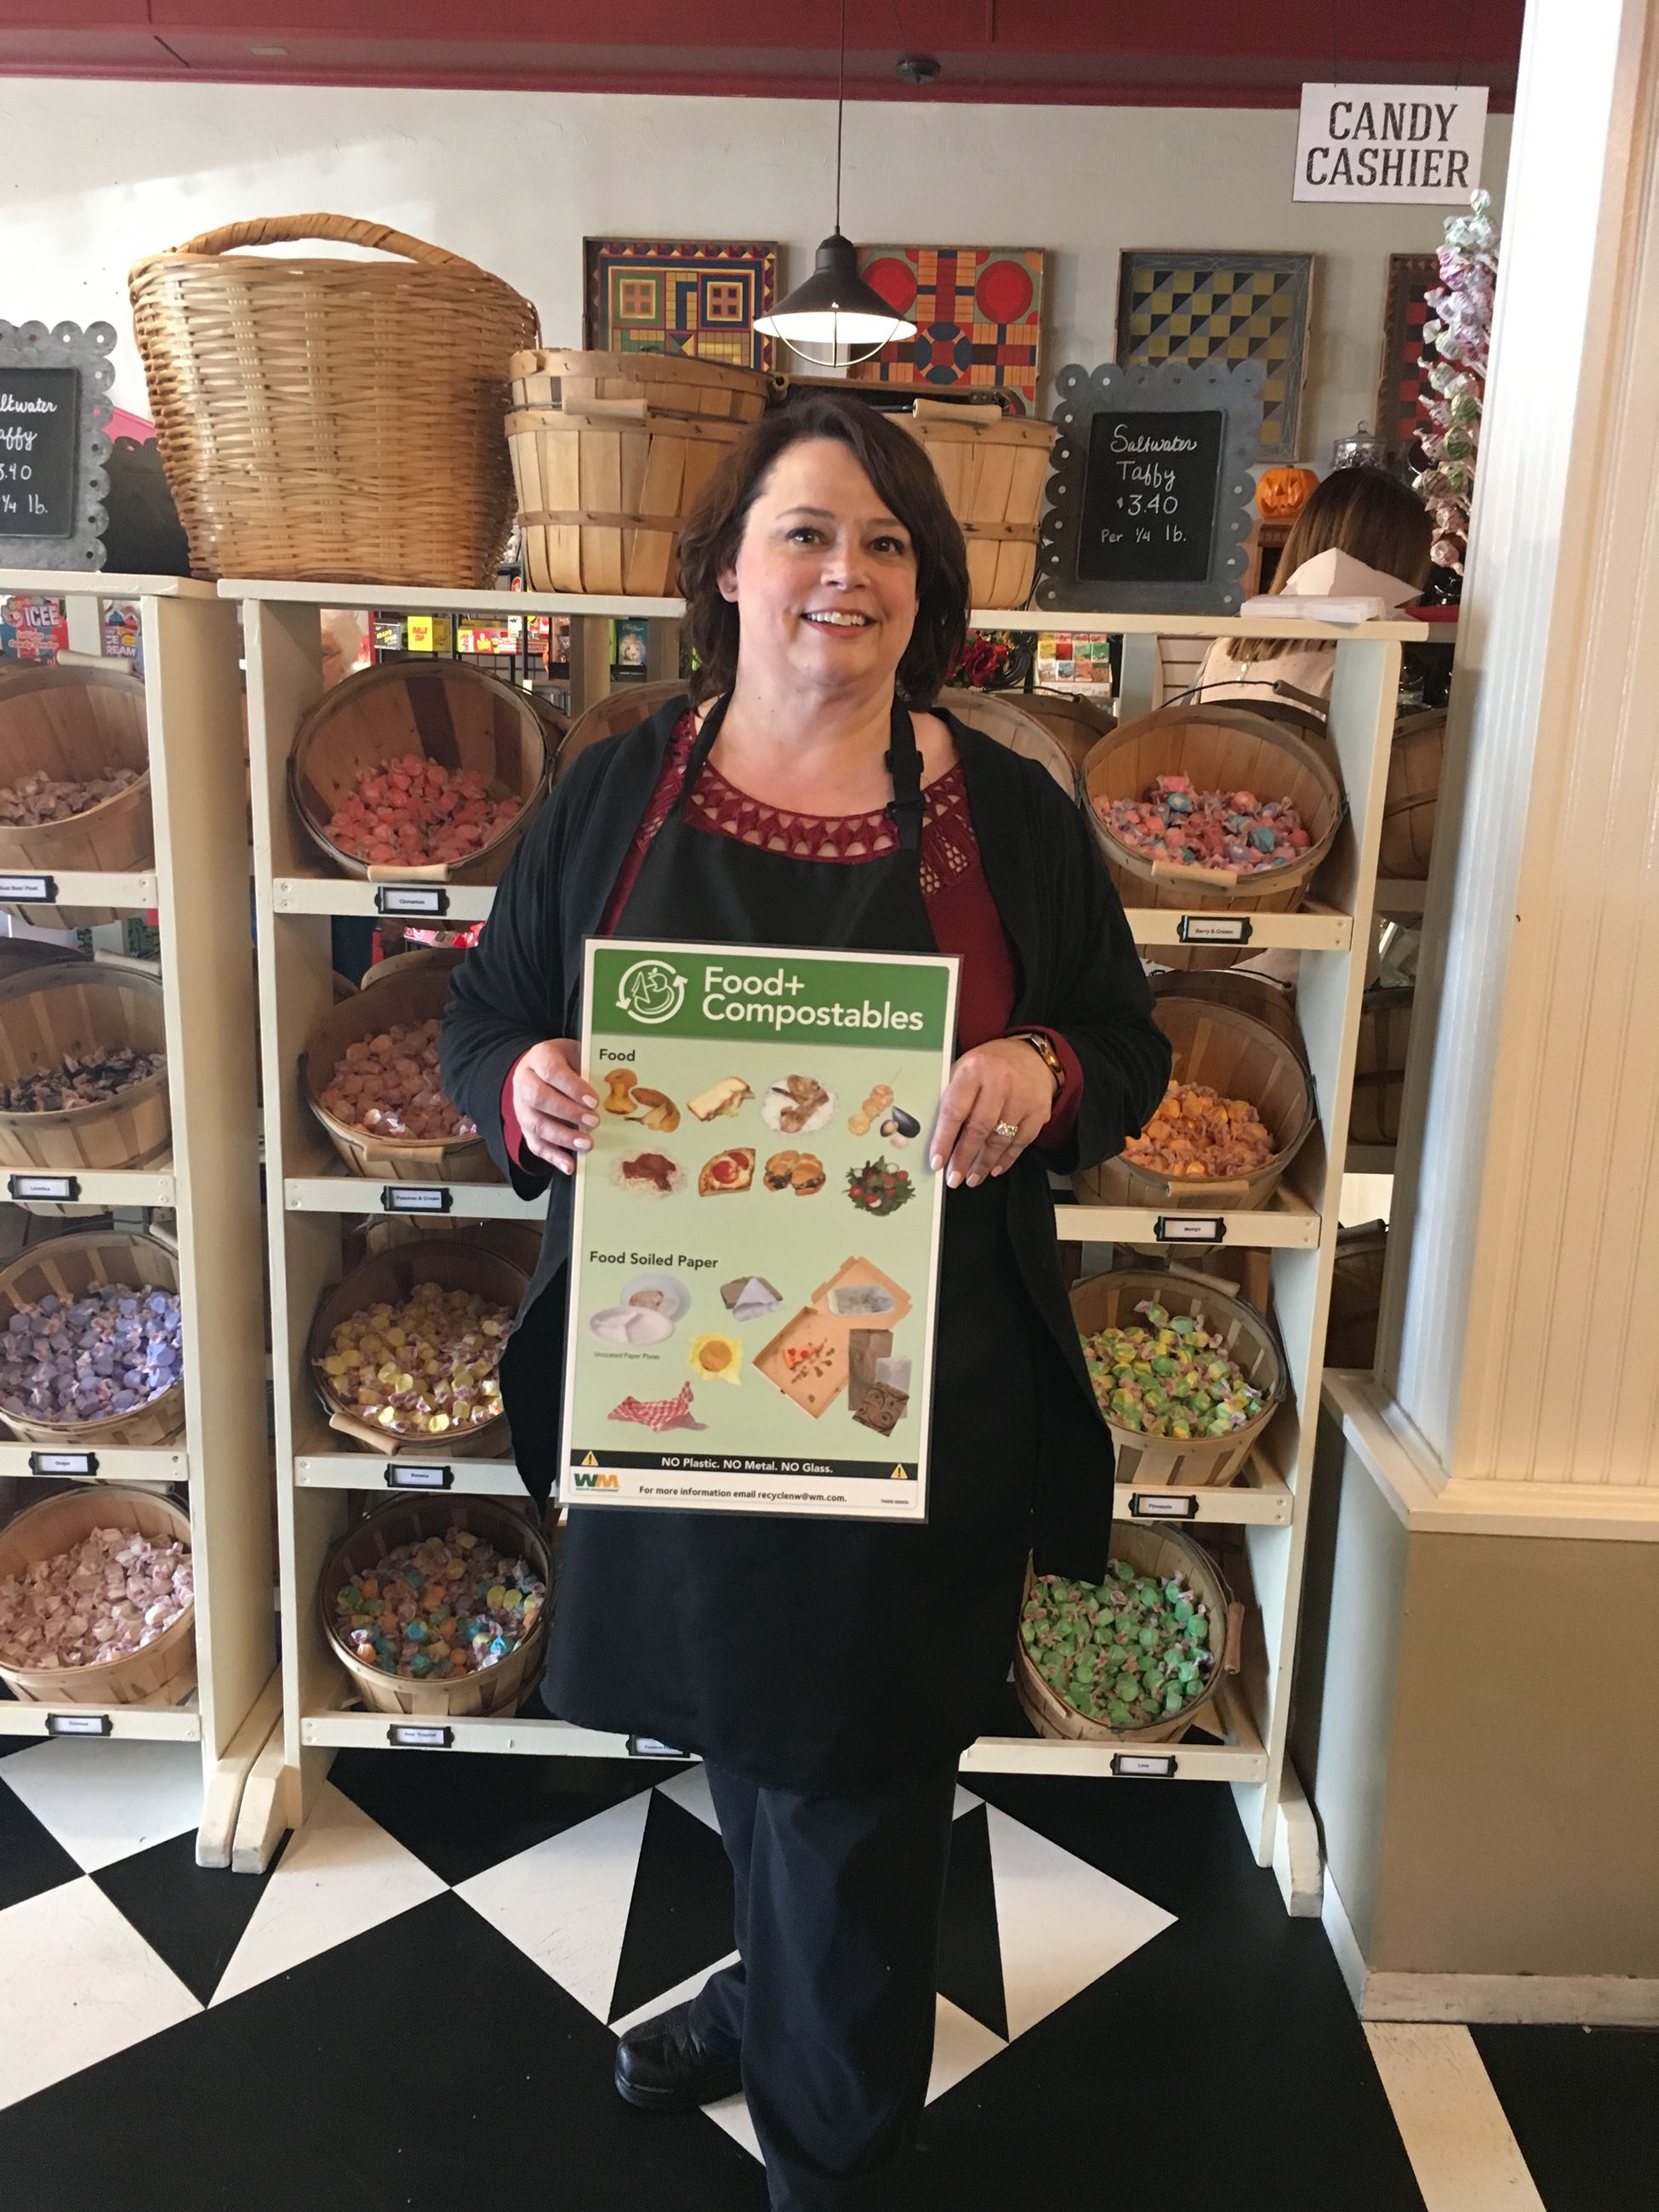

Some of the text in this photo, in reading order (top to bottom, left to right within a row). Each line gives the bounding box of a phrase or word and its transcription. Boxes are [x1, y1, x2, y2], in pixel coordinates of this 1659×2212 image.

[1329, 101, 1458, 142] CANDY
[1306, 146, 1469, 188] CASHIER
[0, 393, 58, 413] ltwater
[0, 426, 38, 451] affy
[1110, 424, 1198, 453] Saltwater
[0, 463, 32, 481] .40
[1116, 460, 1176, 492] Taffy
[1101, 528, 1123, 543] Per
[1166, 524, 1188, 543] lb.
[24, 605, 60, 627] ICEE
[106, 645, 136, 657] REAM
[704, 966, 805, 996] Food+
[702, 993, 924, 1031] Compostables
[599, 1048, 636, 1062] Food
[590, 1251, 719, 1270] Food Soiled Paper
[661, 1457, 834, 1474] NO Plastic. NO Metal. NO Glass.
[573, 1473, 619, 1488] WM
[680, 1488, 732, 1497] information
[757, 1491, 847, 1502] recyclenw@wm.com.
